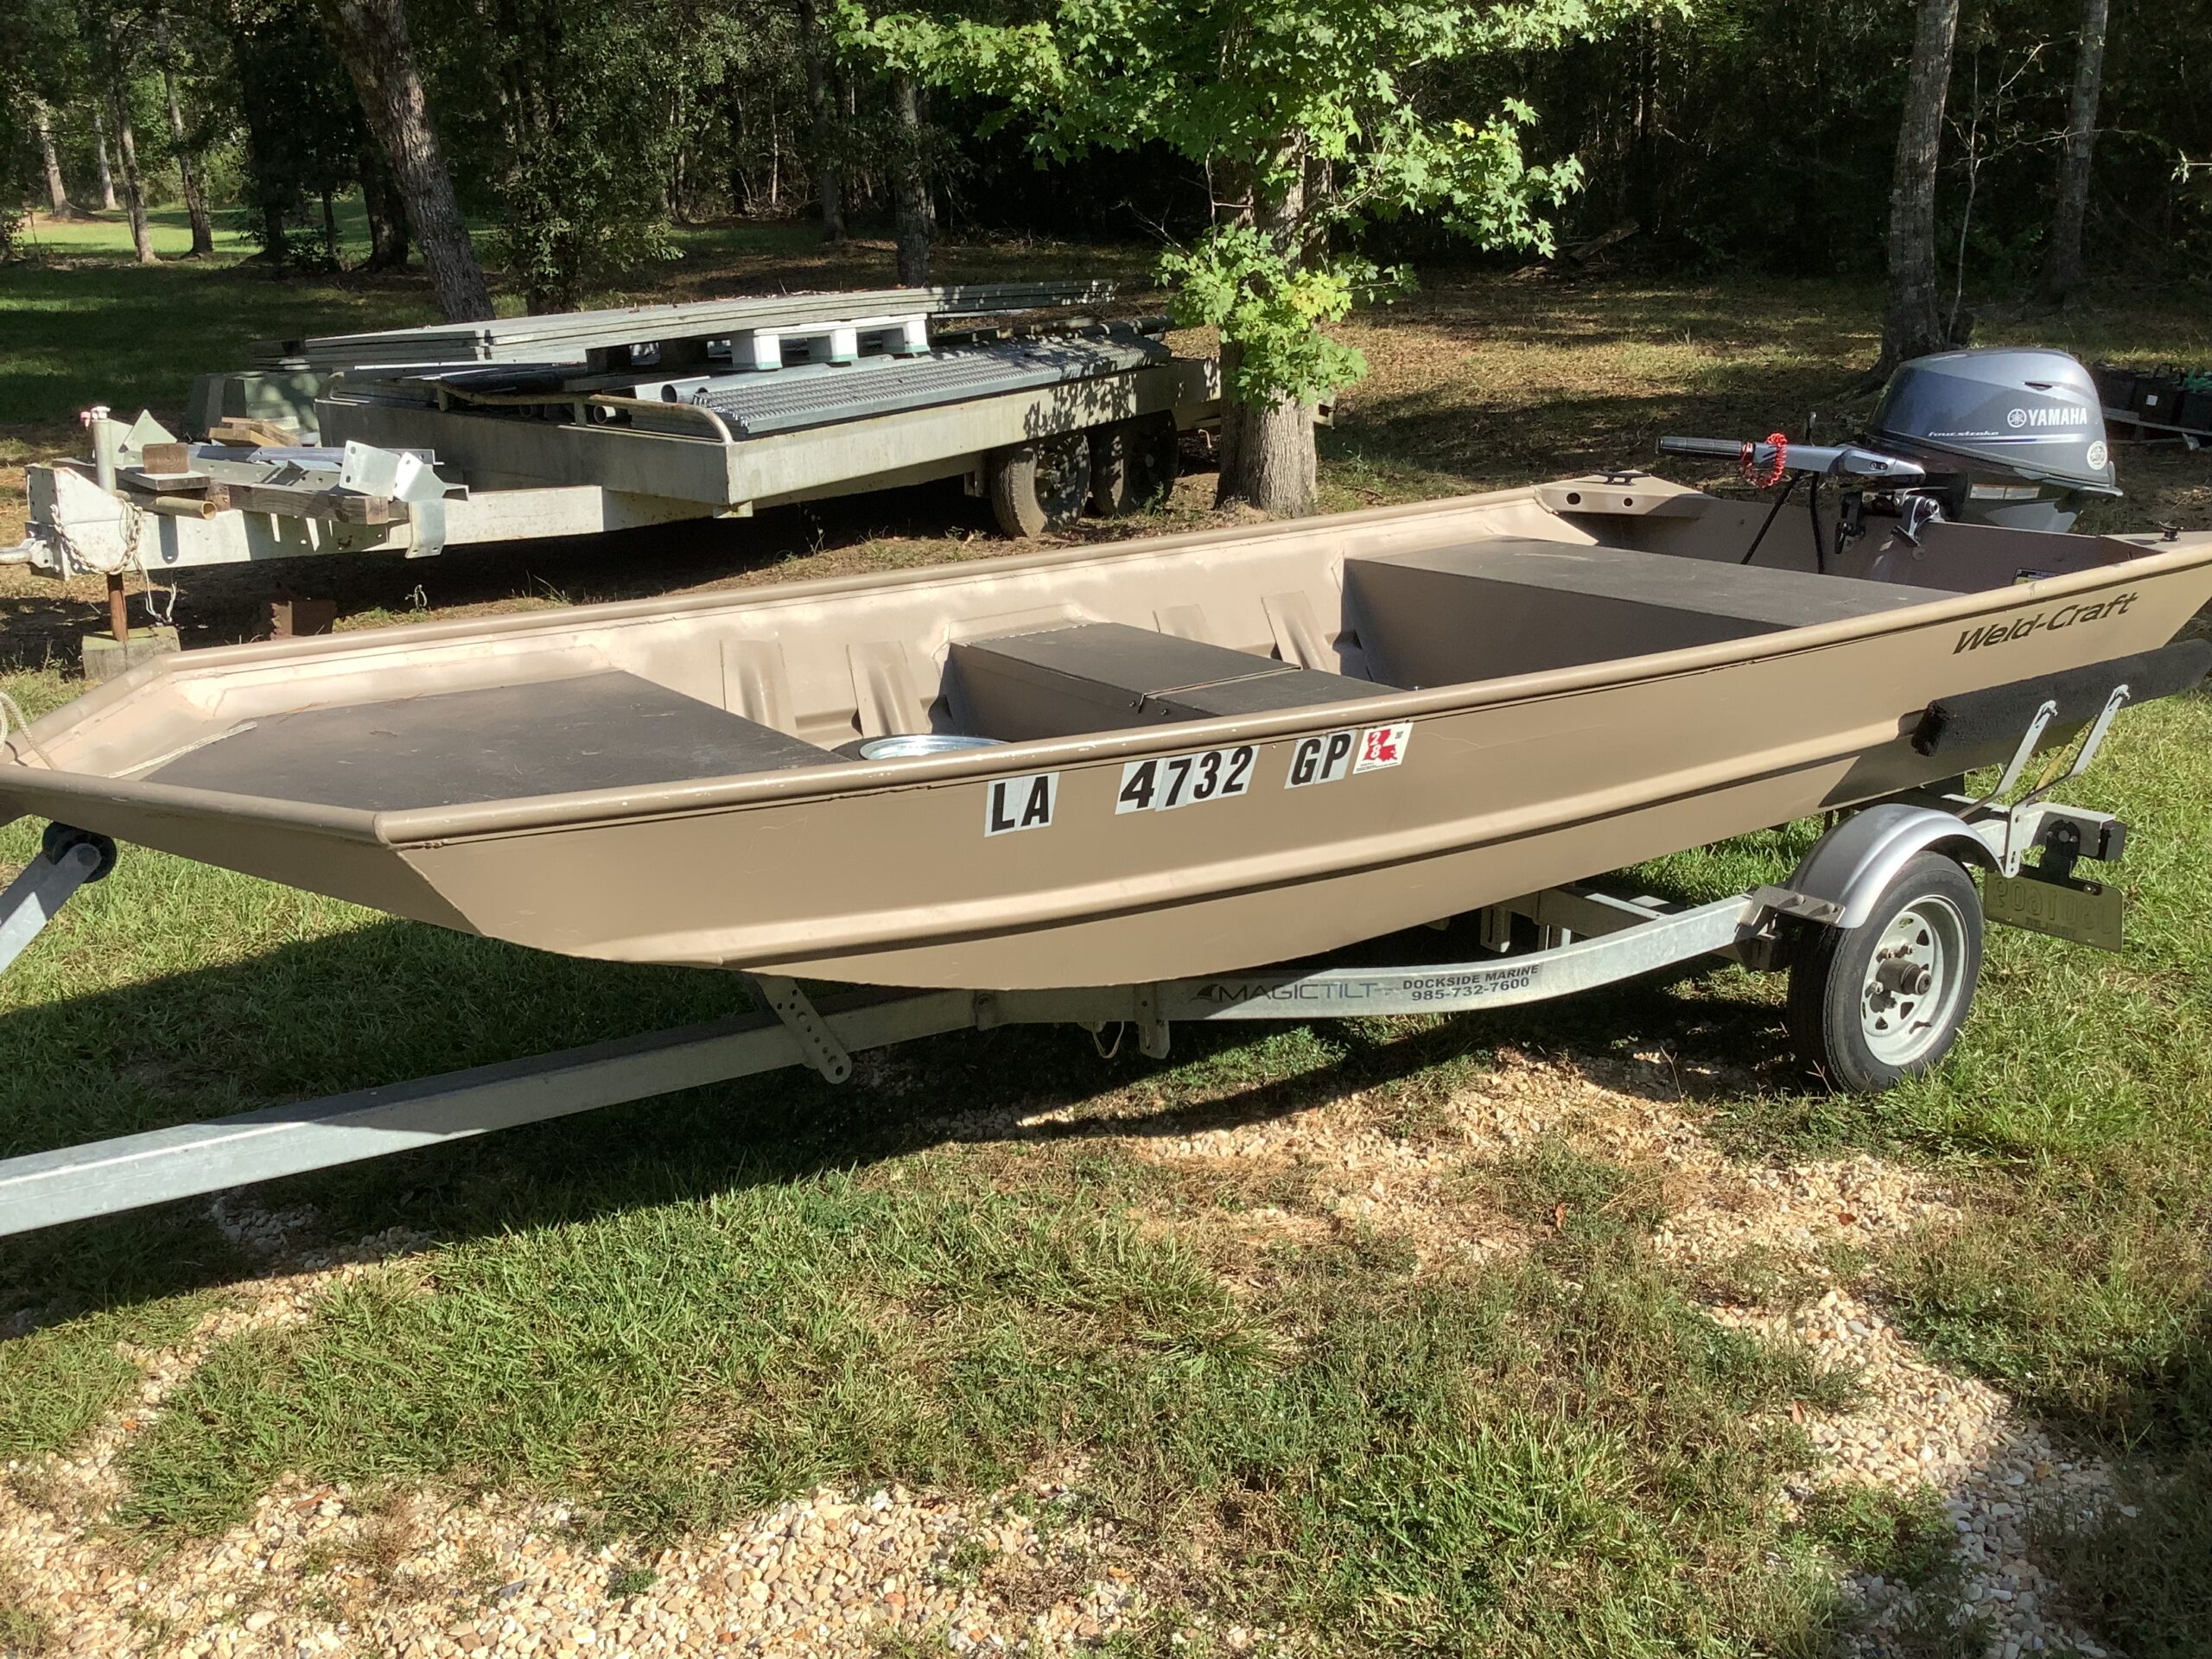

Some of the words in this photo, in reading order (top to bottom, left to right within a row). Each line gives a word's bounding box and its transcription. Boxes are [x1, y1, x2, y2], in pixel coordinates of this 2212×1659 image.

[2028, 408, 2088, 426] YAMAHA
[1951, 591, 2139, 655] Weld-Craft
[990, 775, 1049, 833] LA
[1119, 745, 1253, 809] 4732
[1295, 734, 1352, 785] GP
[1402, 975, 1480, 990] DOCKSIDE
[1484, 964, 1540, 982] MARINE
[1411, 977, 1529, 1001] 985-732-7600
[1218, 982, 1377, 1002] MAGICTILT
